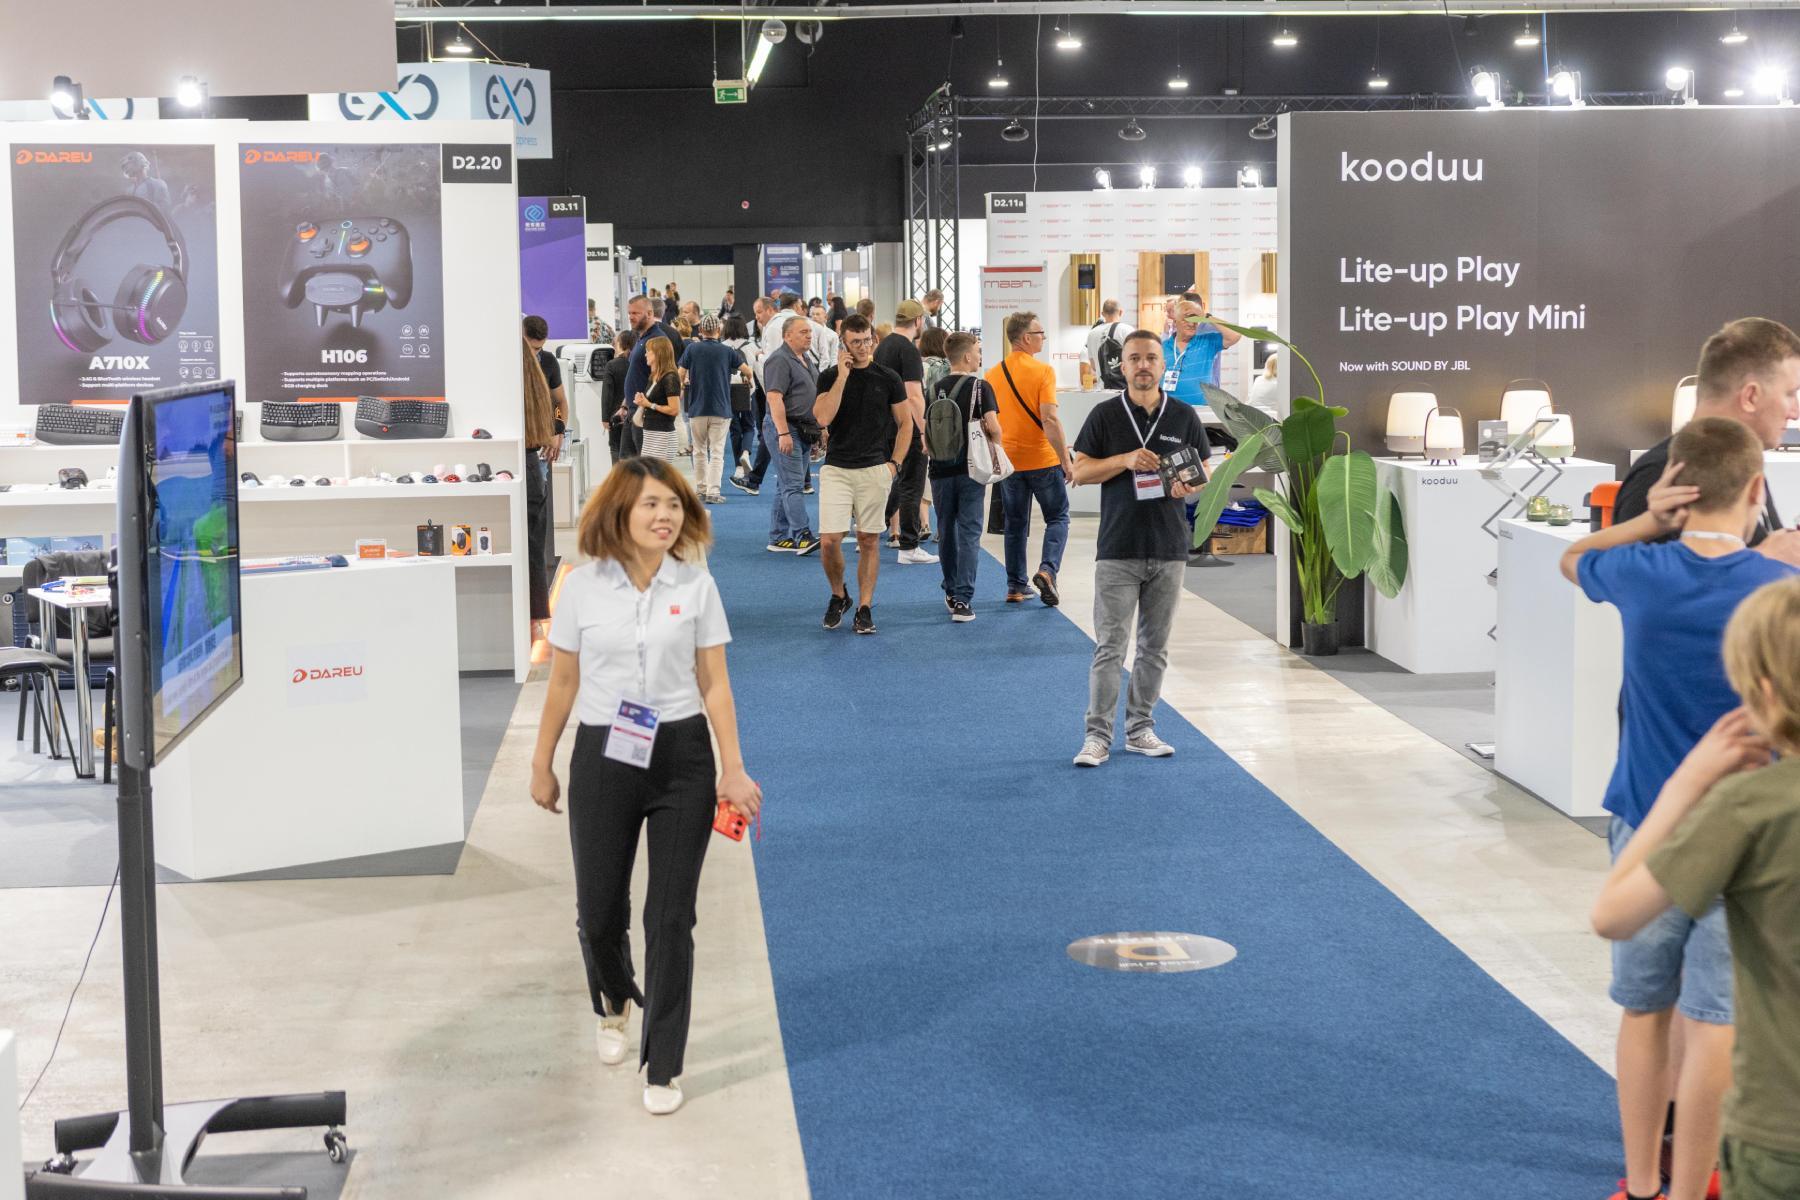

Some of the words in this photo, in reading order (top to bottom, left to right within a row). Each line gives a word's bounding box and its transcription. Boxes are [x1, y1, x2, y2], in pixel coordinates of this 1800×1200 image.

[34, 151, 93, 163] DAREU
[263, 151, 320, 162] DAREU
[452, 155, 502, 170] D2.20
[1340, 151, 1483, 182] kooduu
[552, 202, 579, 212] D3.11
[993, 199, 1024, 207] D2.11a
[1339, 257, 1448, 288] Lite-up
[1457, 256, 1520, 288] Play
[984, 280, 1032, 288] maan
[1339, 306, 1448, 337] Lite-up
[1456, 305, 1520, 336] Play
[1528, 304, 1586, 330] Mini
[321, 350, 368, 363] H106
[88, 356, 150, 370] A710X
[1339, 361, 1363, 372] Now
[1366, 361, 1389, 372] with
[1391, 361, 1431, 371] SOUND
[1434, 360, 1448, 371] BY
[1450, 360, 1471, 371] JBL
[1421, 477, 1459, 485] kooduu
[310, 665, 363, 680] DAREU
